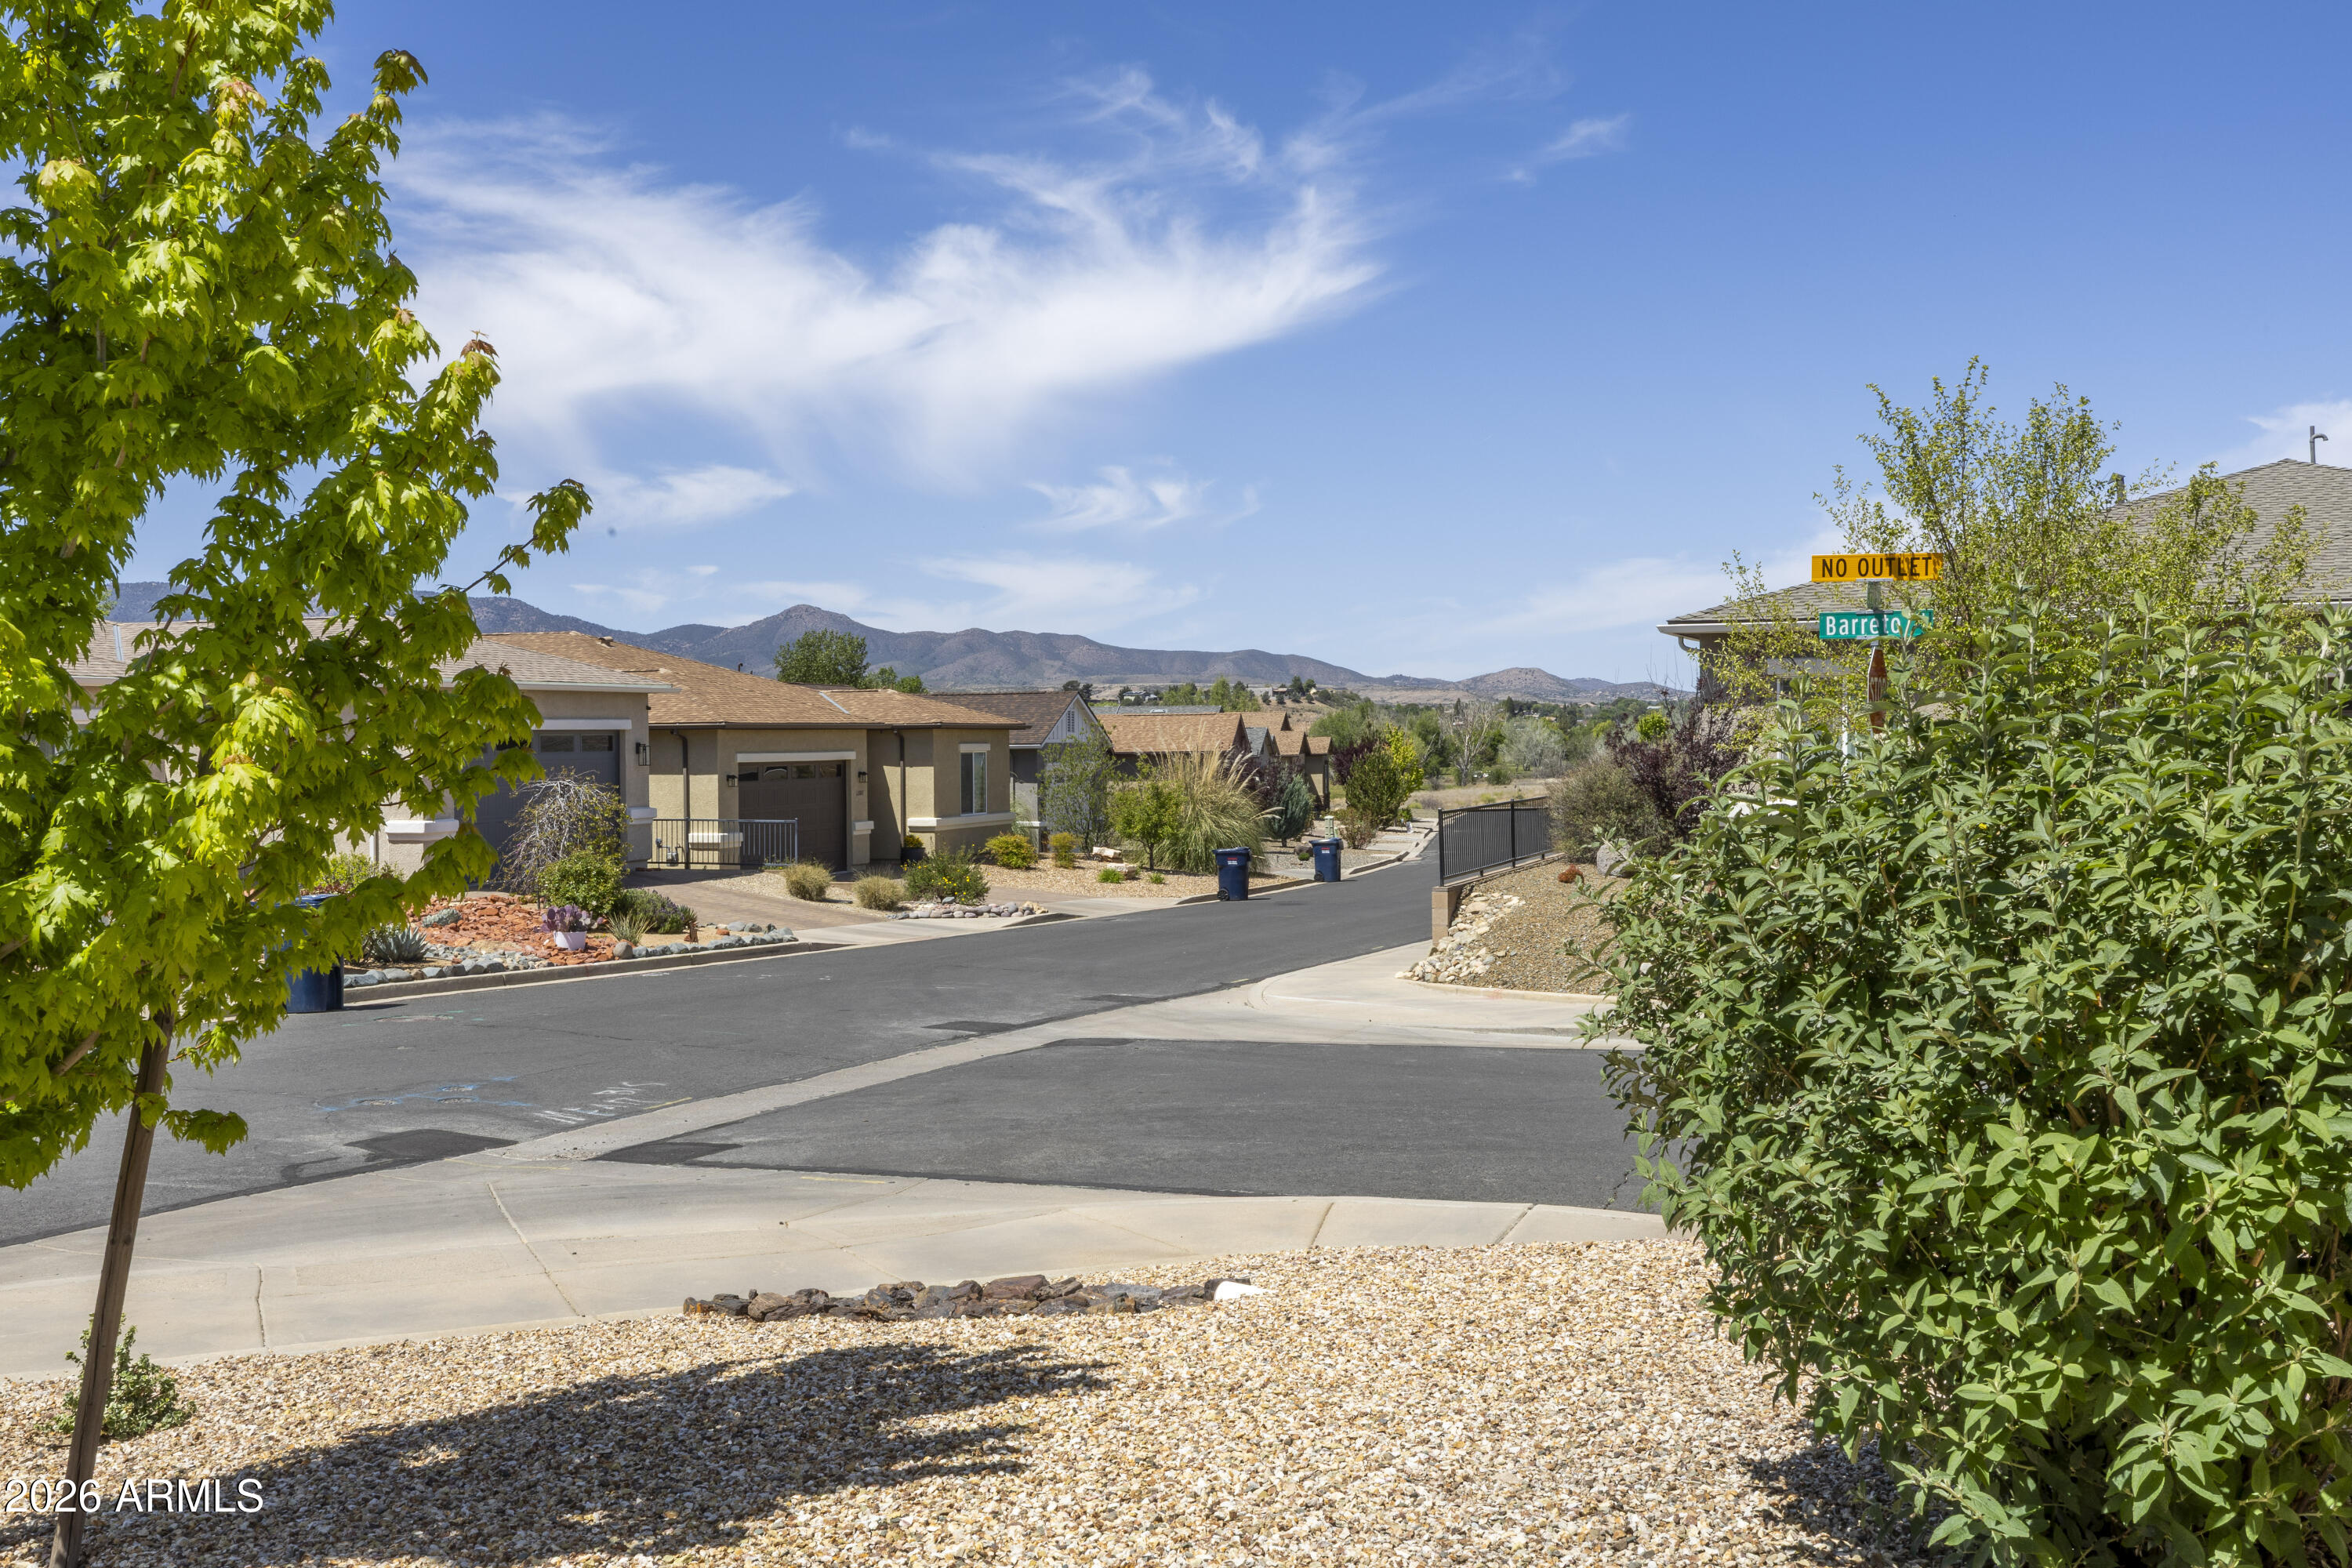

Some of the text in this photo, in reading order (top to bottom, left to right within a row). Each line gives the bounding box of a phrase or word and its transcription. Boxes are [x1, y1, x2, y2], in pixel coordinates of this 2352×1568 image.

[1821, 557, 1932, 578] NO OUTLET
[1826, 615, 1901, 636] Barreto
